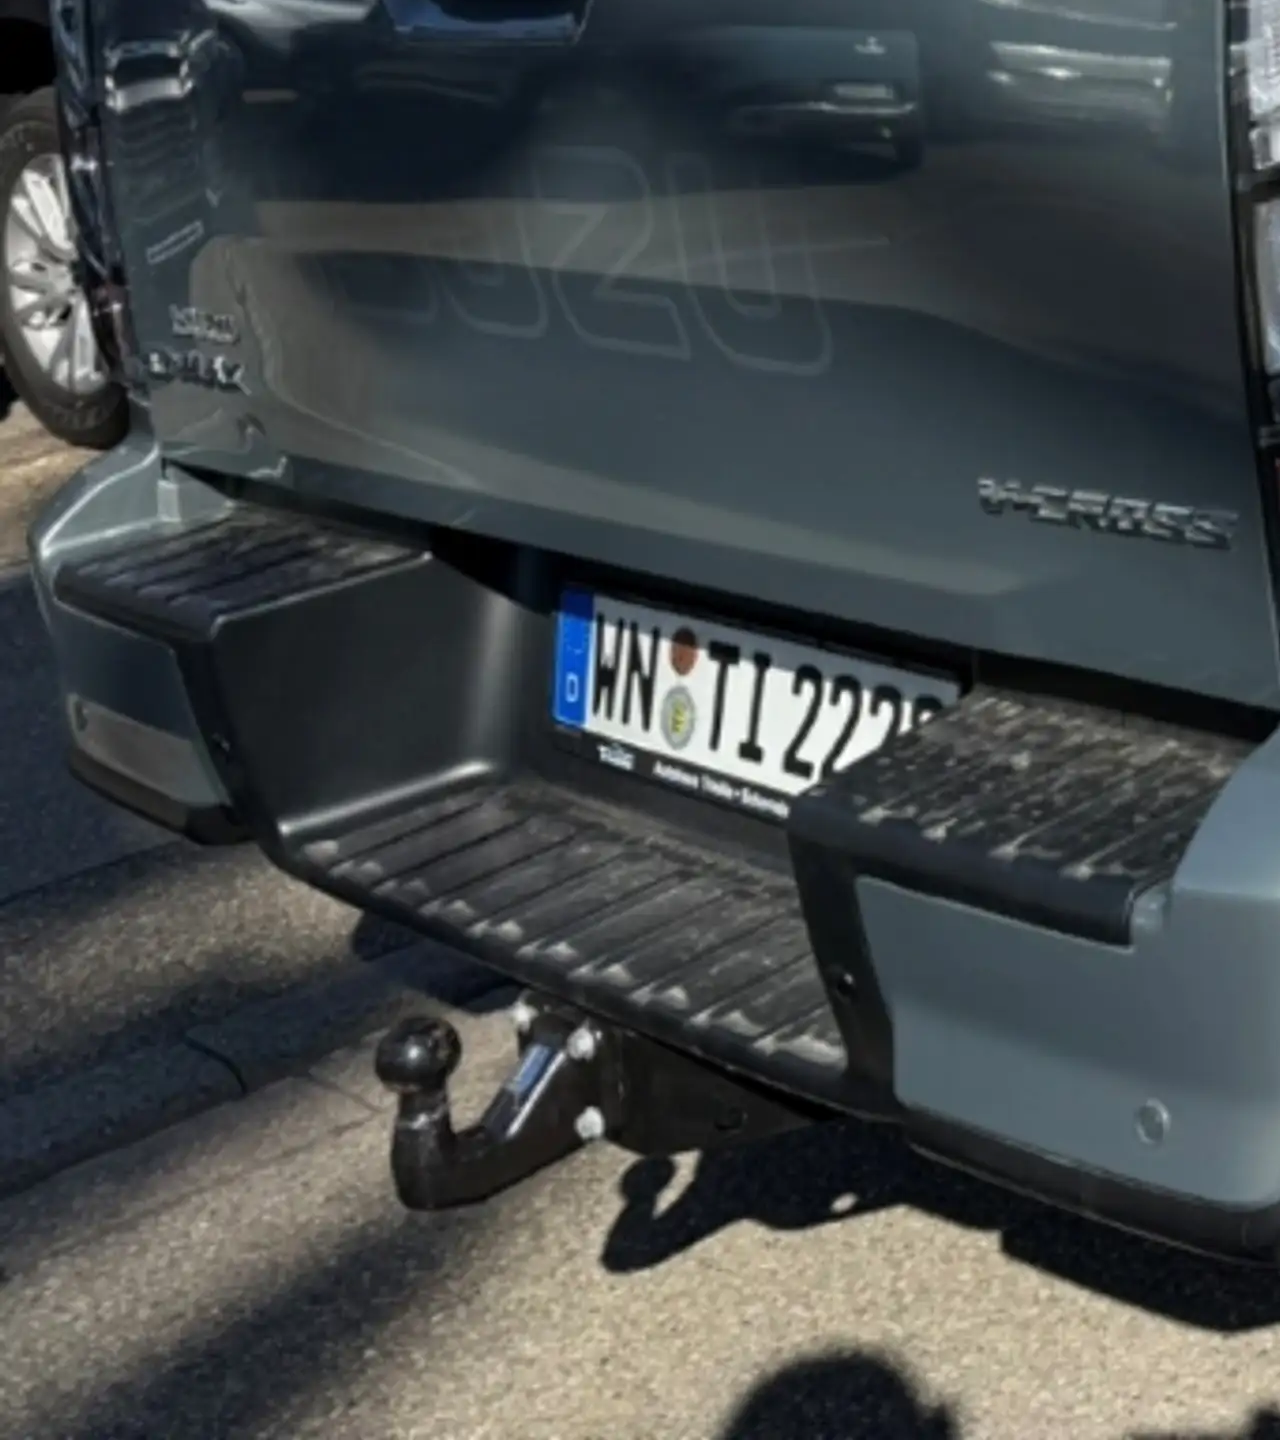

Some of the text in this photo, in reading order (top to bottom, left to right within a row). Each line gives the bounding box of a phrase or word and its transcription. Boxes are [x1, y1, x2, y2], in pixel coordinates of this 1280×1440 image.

[592, 612, 946, 788] WN TI 222
